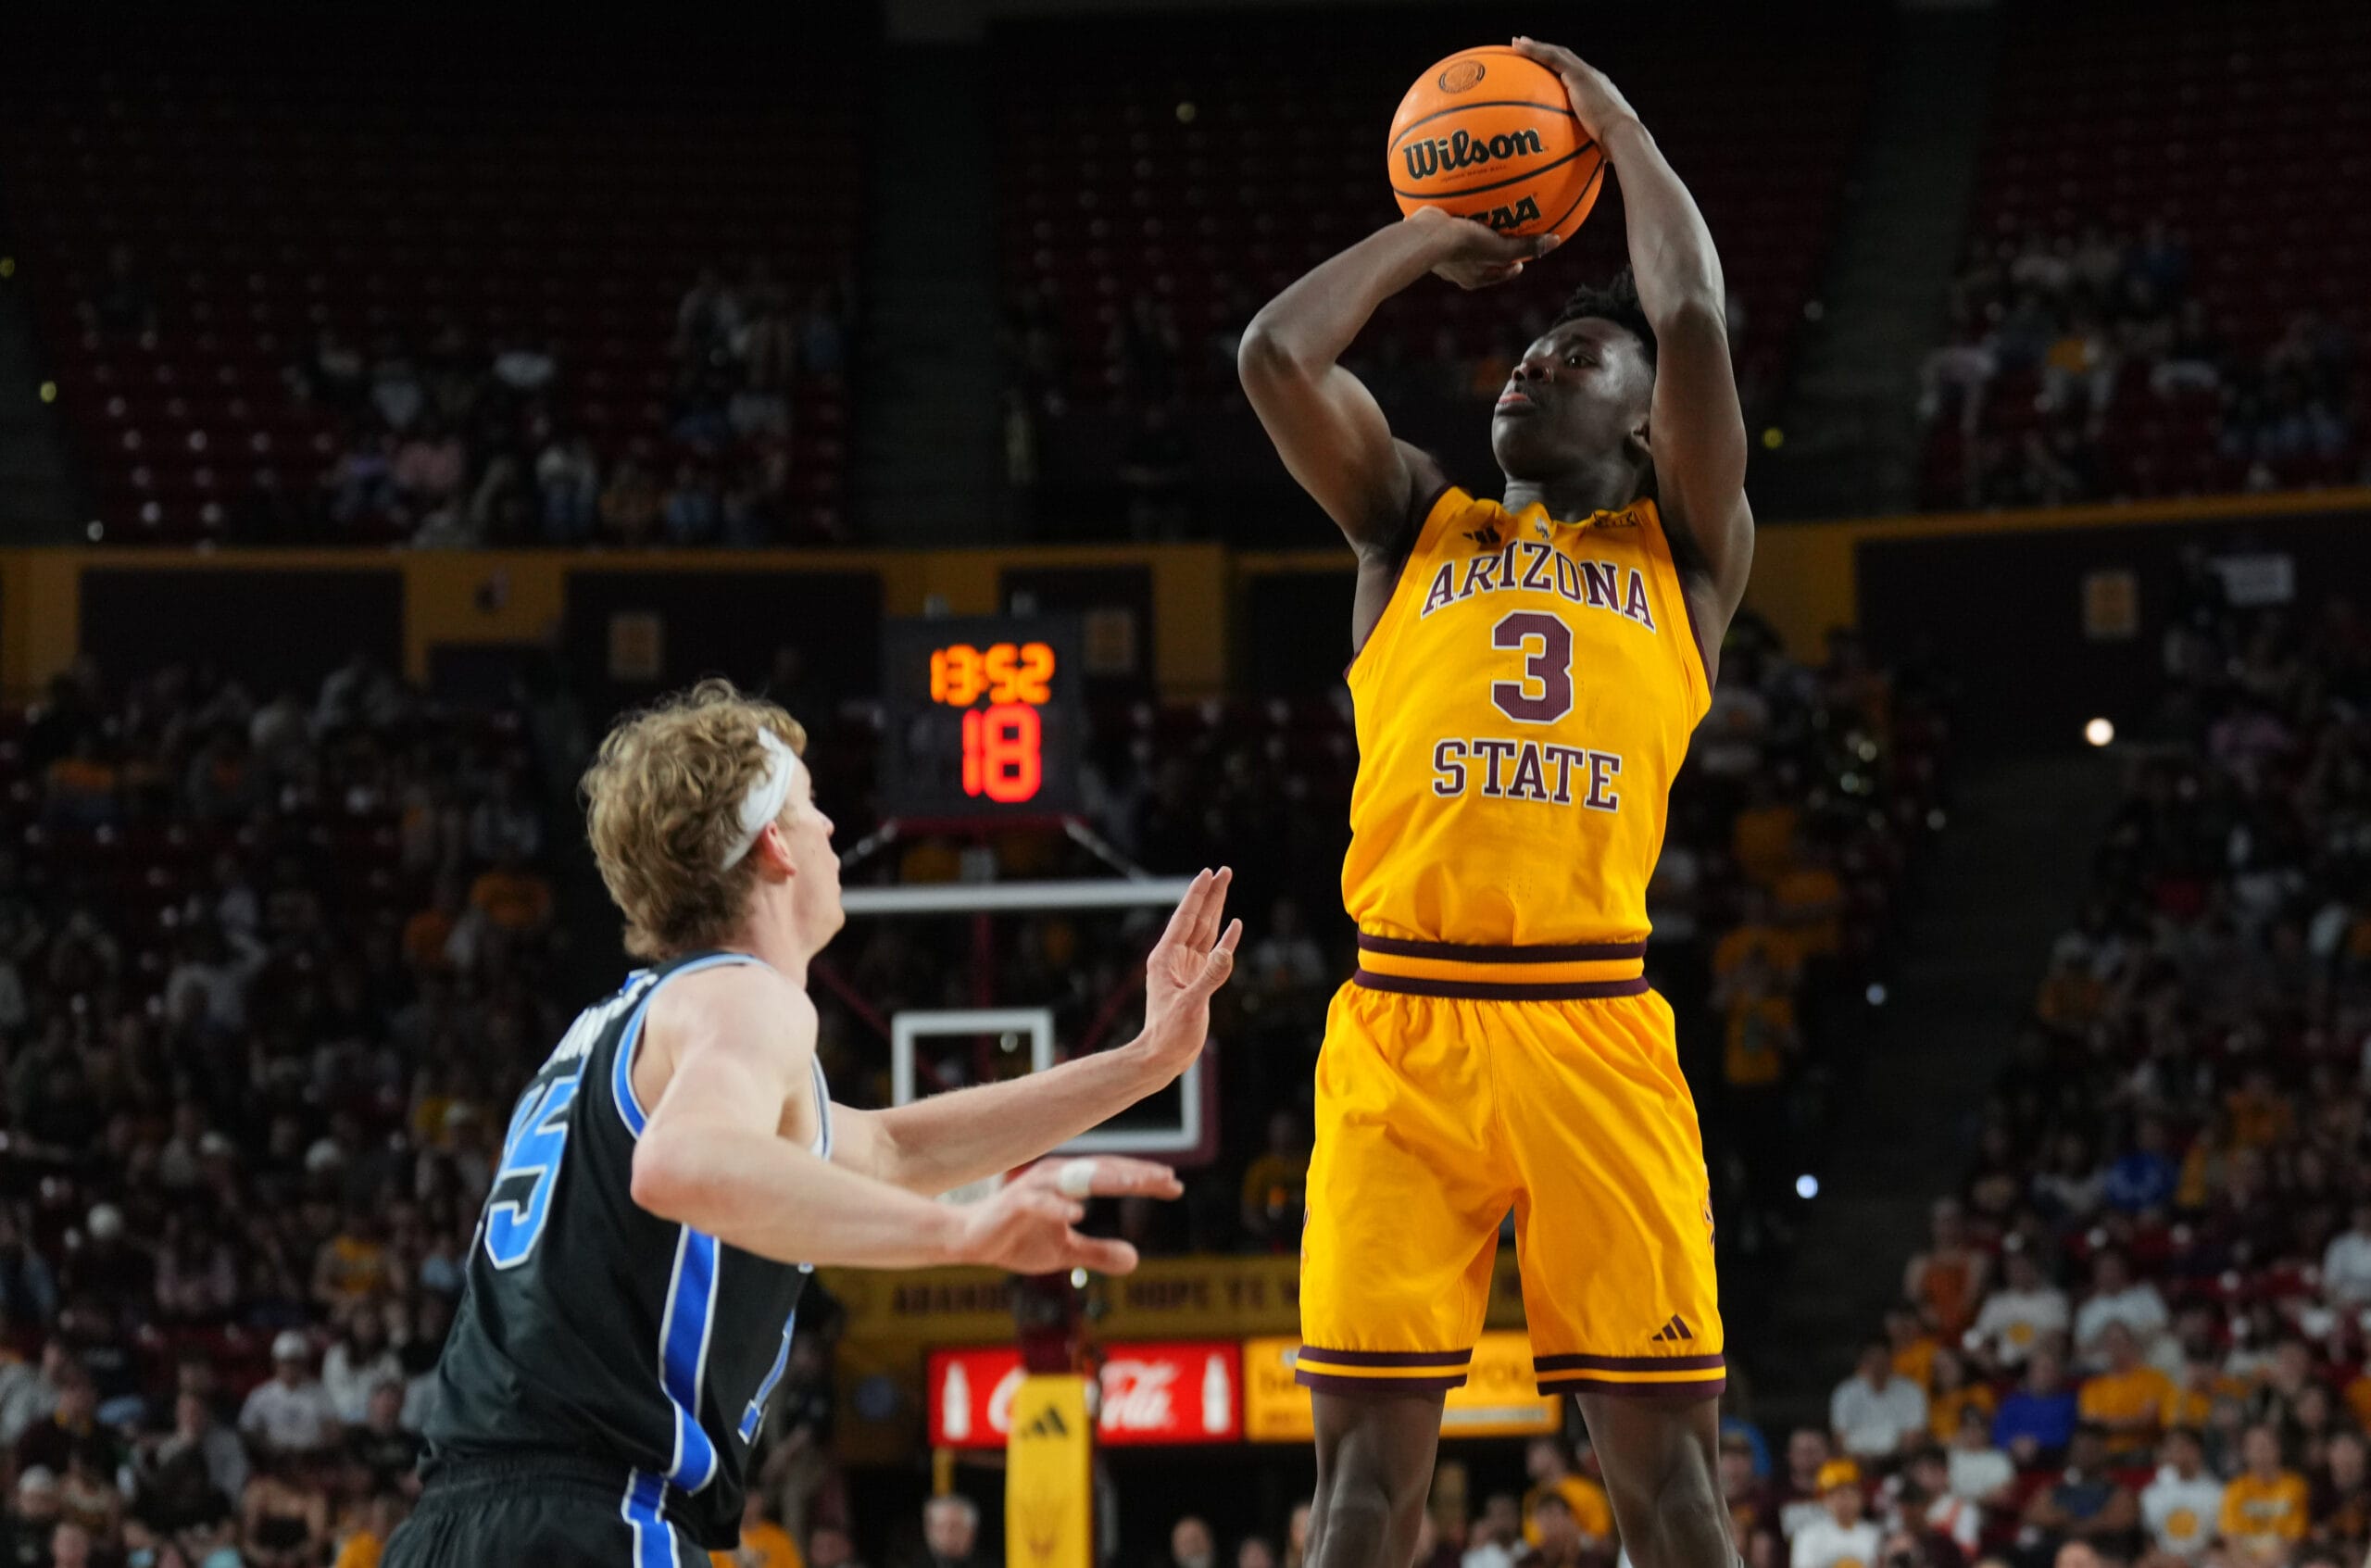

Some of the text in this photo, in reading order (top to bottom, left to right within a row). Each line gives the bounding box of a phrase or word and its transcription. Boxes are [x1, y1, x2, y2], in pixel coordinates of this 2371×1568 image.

[1403, 128, 1544, 180] Wilson
[1451, 195, 1541, 231] AA
[1420, 539, 1656, 633] ARIZONA
[930, 642, 1056, 707] 13:52
[1491, 609, 1574, 724] 3
[961, 703, 1042, 803] 18
[1432, 738, 1623, 813] STATE
